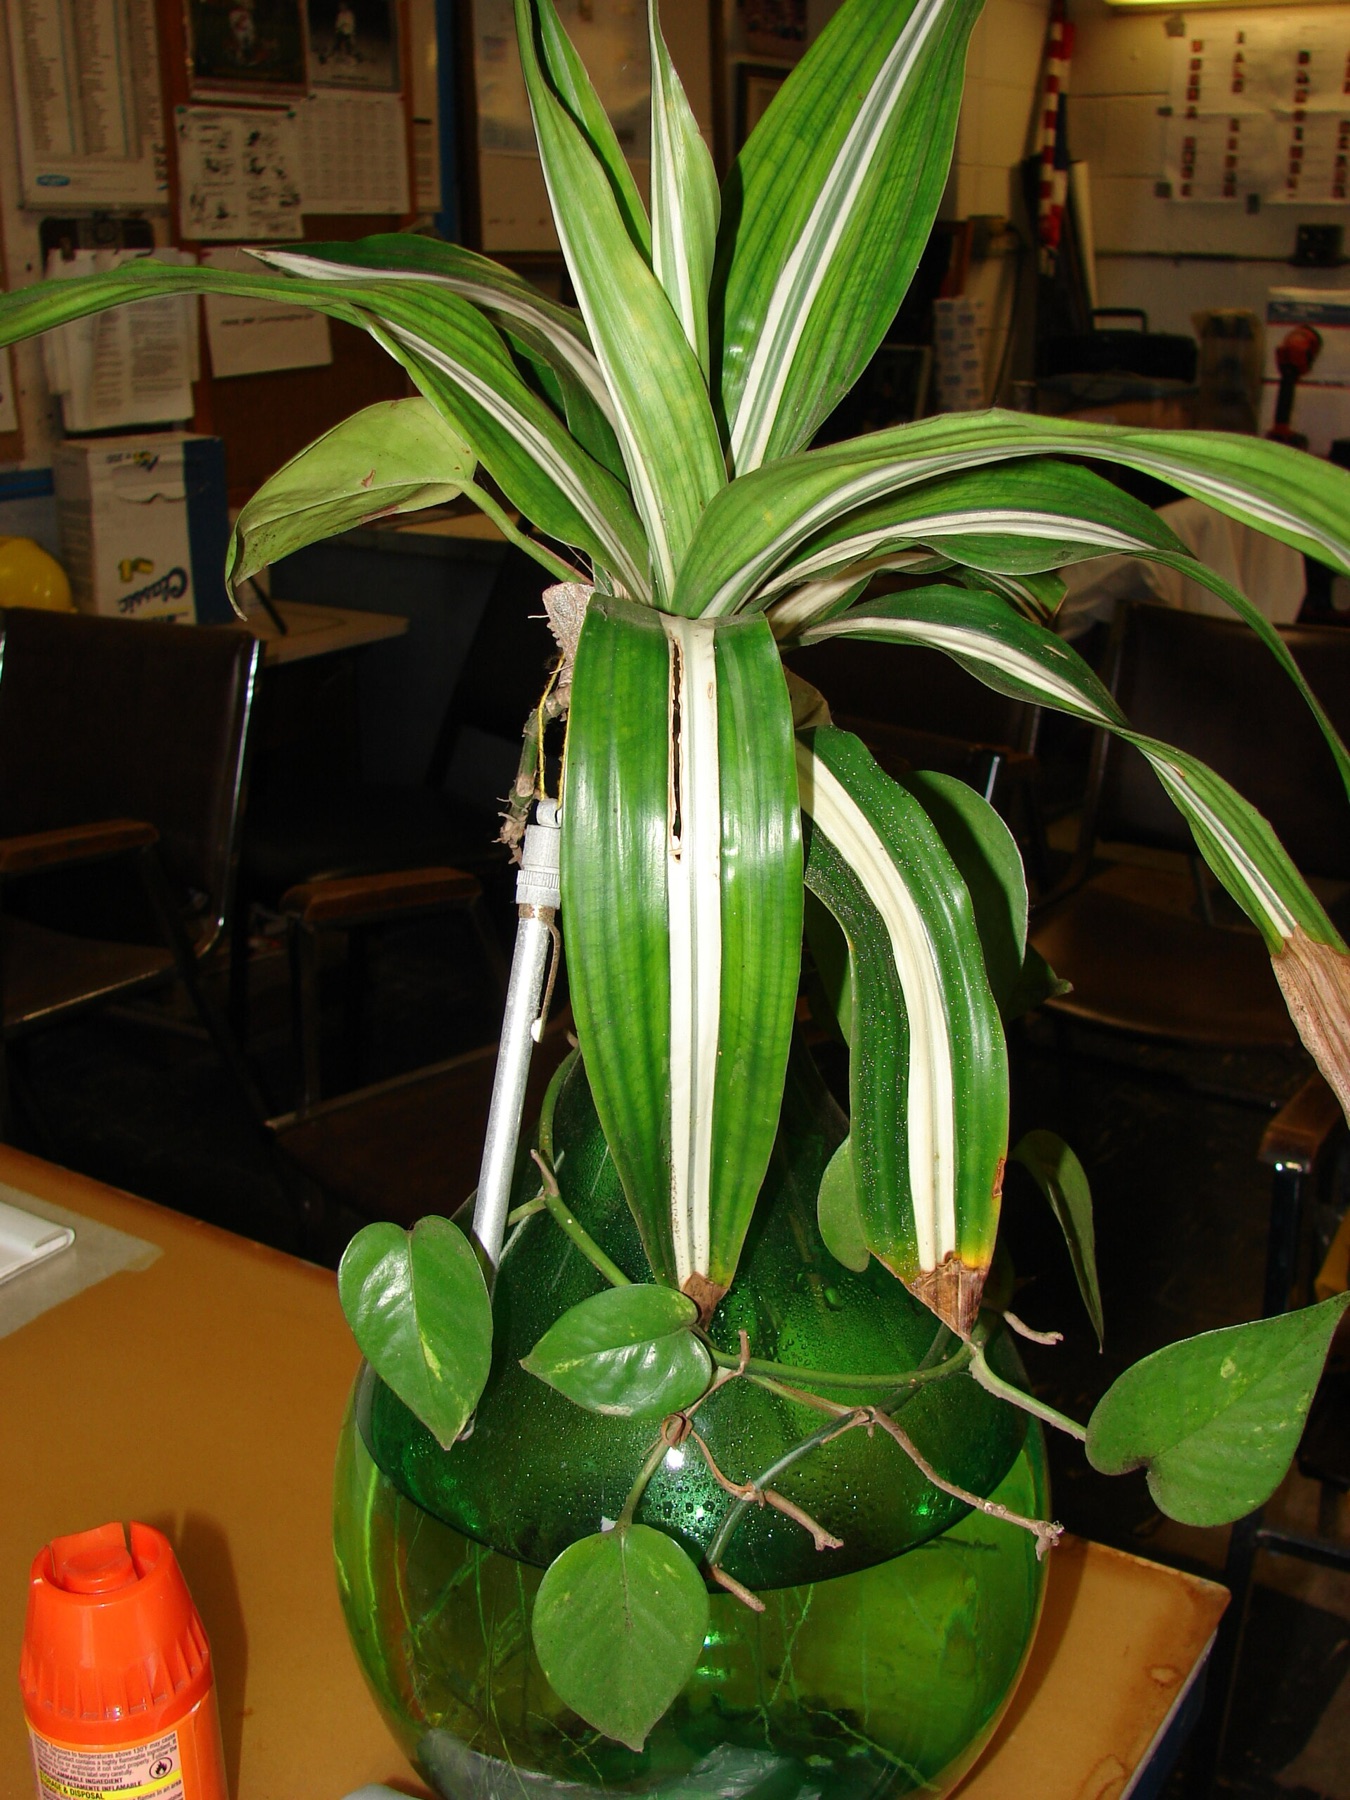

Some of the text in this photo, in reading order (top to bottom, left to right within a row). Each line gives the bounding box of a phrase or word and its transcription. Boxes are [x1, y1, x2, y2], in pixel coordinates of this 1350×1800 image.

[118, 567, 187, 614] Classic
[78, 1752, 113, 1760] temperatures
[115, 1750, 131, 1758] above
[149, 1740, 160, 1749] may
[161, 1733, 176, 1744] cause
[75, 1758, 96, 1766] contains
[119, 1752, 146, 1763] flammable
[112, 1763, 126, 1771] used
[169, 1745, 177, 1753] the
[52, 1767, 83, 1783] FLAMMABLE
[85, 1777, 123, 1785] INGREDIENT
[63, 1786, 68, 1794] &
[69, 1788, 105, 1800] DISPOSAL
[67, 1781, 101, 1792] ALTAMENTE
[101, 1779, 142, 1792] INFLAMABLE
[163, 1785, 171, 1793] an
[171, 1779, 182, 1789] area
